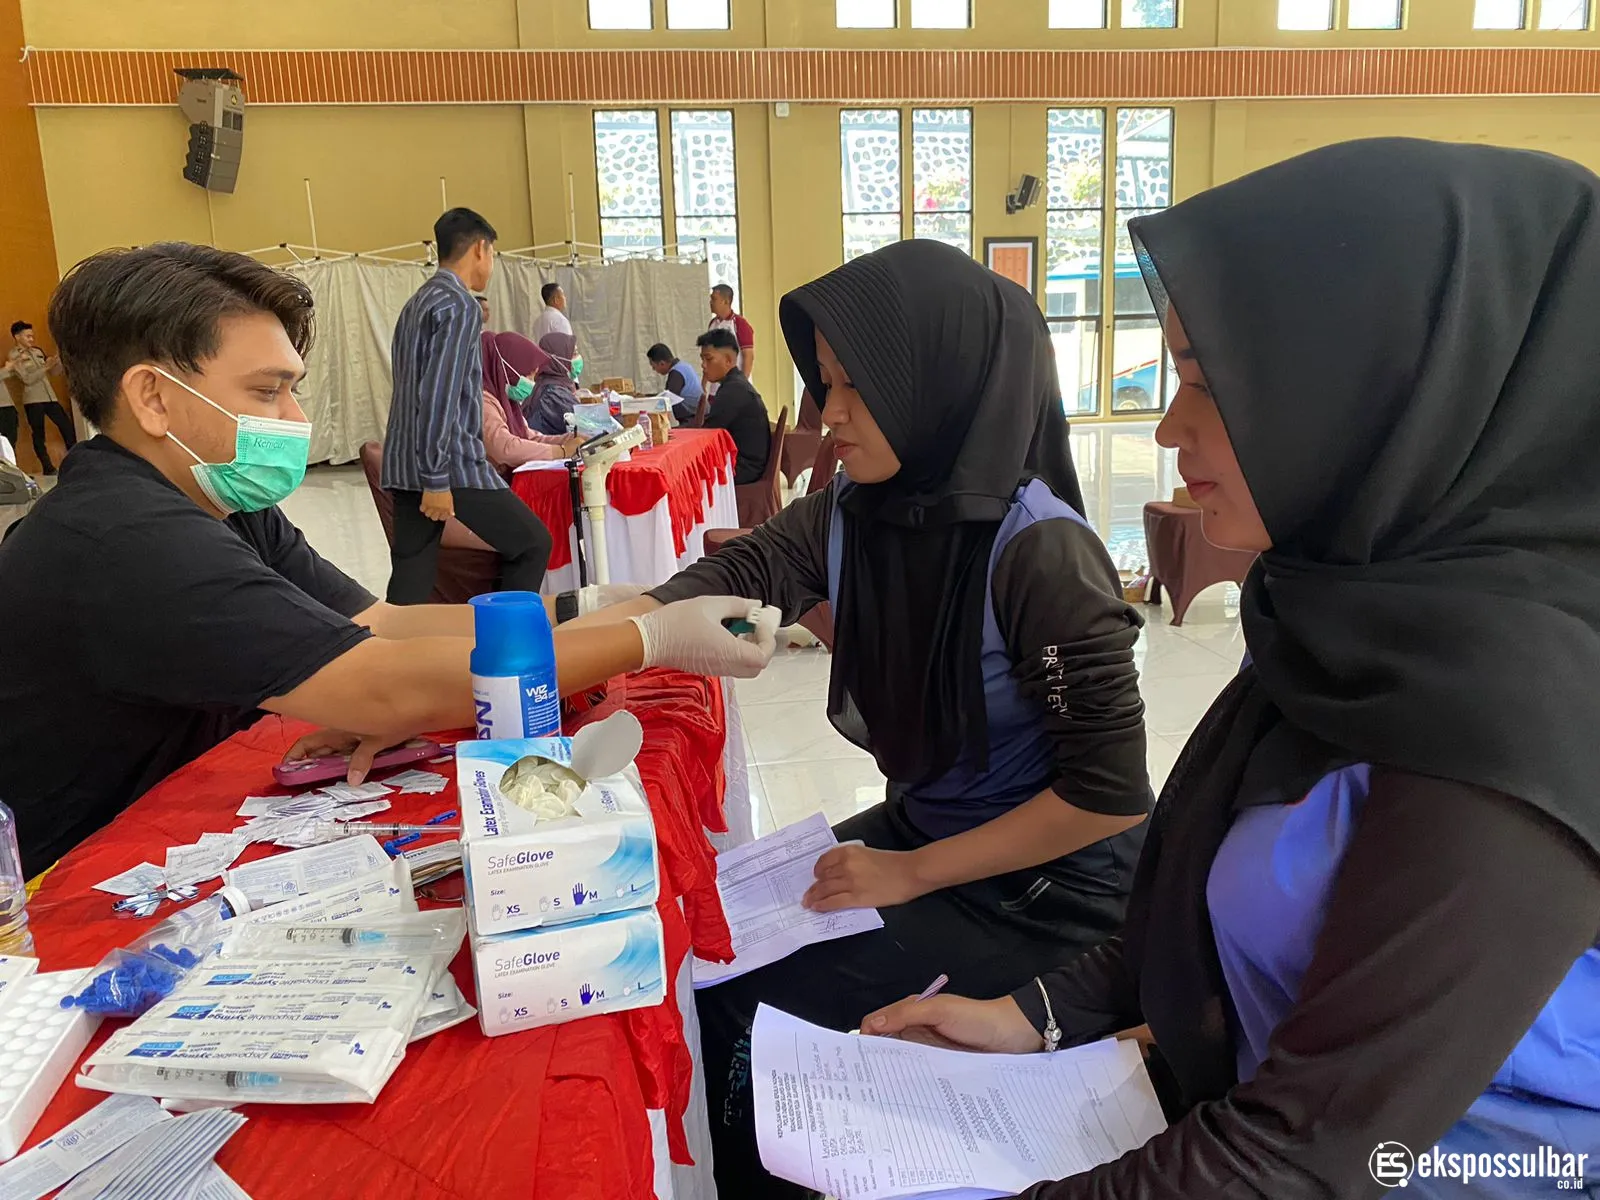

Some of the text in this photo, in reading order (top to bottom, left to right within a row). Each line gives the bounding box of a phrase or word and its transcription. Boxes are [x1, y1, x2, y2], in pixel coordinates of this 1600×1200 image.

[526, 684, 548, 697] WIZ
[534, 692, 548, 703] 24
[473, 770, 499, 837] Latex Examination Gloves
[488, 850, 554, 869] SafeGlove
[631, 883, 638, 892] L
[589, 890, 598, 900] M
[553, 897, 561, 906] S
[506, 904, 521, 914] XS
[494, 951, 560, 972] SafeGlove
[637, 982, 645, 990] L
[596, 990, 605, 999] M
[560, 998, 568, 1007] S
[514, 1007, 528, 1017] XS
